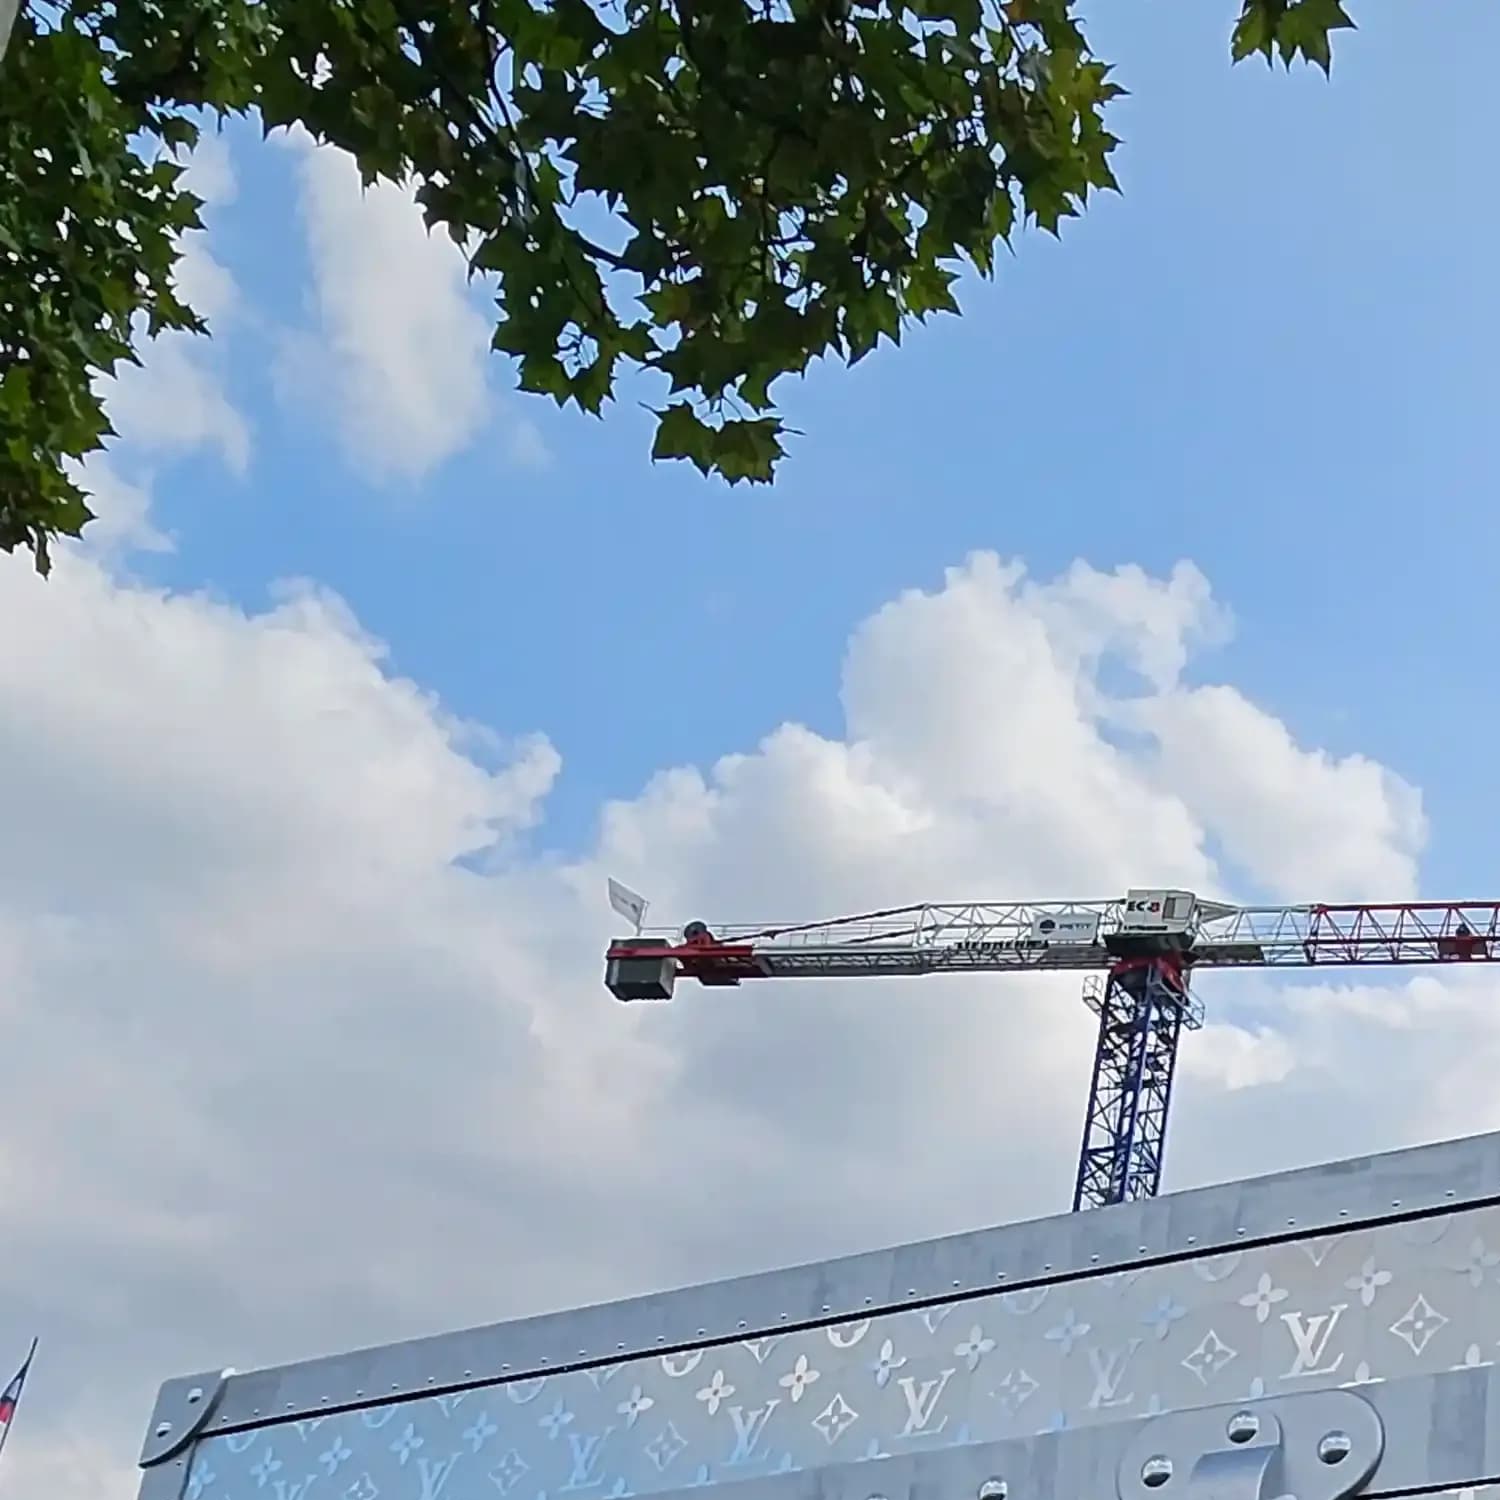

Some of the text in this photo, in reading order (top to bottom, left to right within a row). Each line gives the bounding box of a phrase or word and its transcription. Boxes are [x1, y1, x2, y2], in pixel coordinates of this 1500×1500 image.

[1087, 1338, 1142, 1407] LV
[1279, 1304, 1349, 1379] LV
[727, 1399, 781, 1465] LV
[894, 1369, 956, 1437] LV
[559, 1426, 615, 1491] LV
